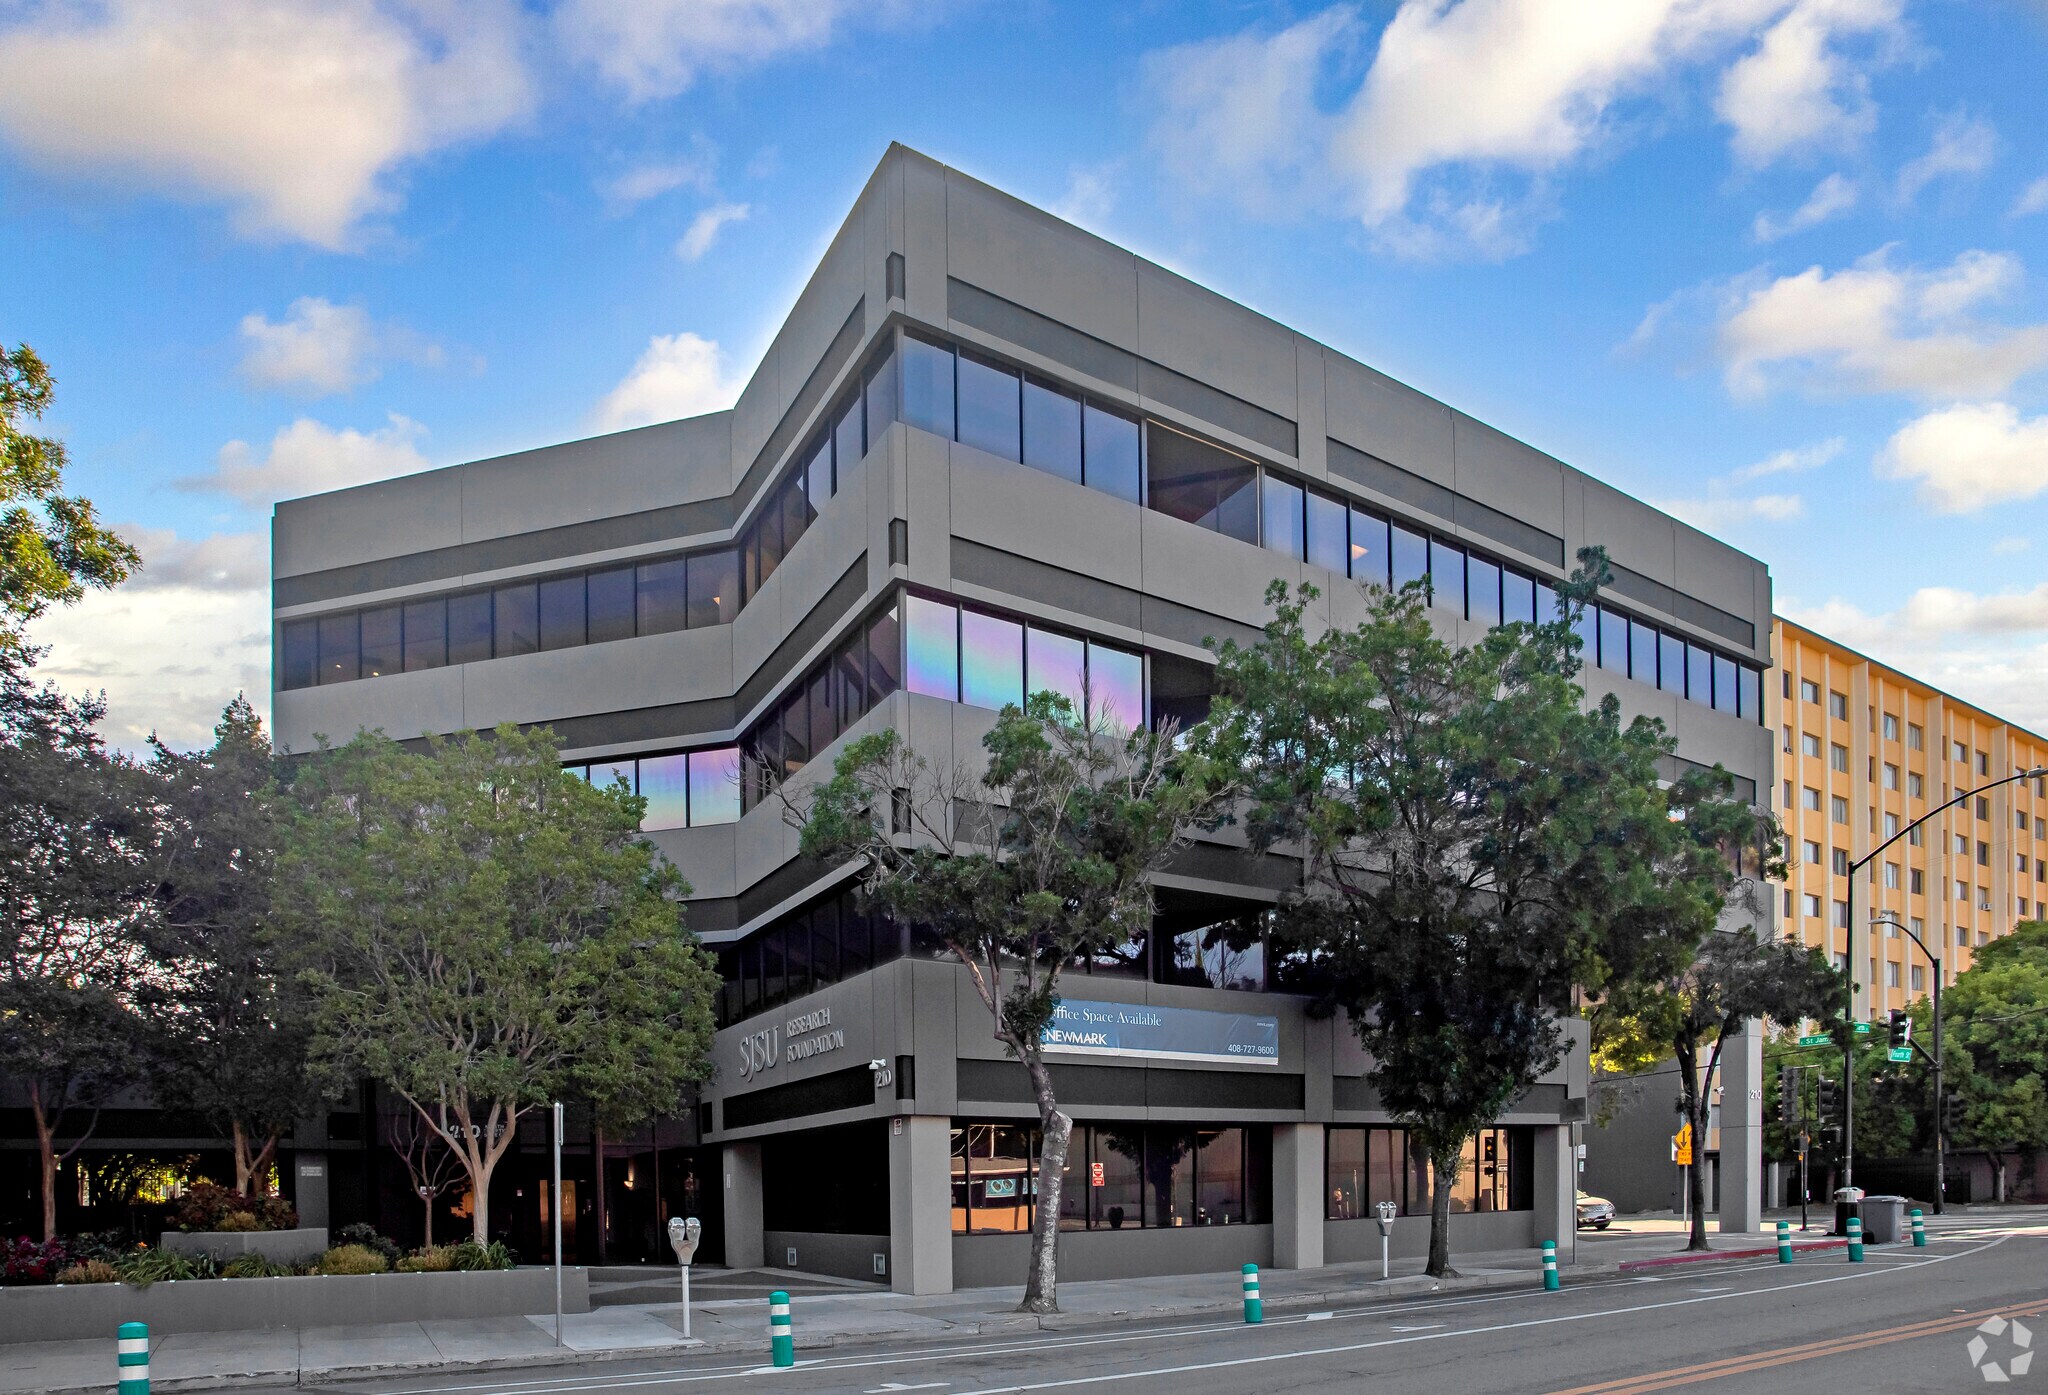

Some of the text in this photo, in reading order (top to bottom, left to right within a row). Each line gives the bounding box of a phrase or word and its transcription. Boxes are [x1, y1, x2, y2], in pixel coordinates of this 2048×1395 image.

[786, 1007, 831, 1038] RESEARCH
[1083, 1007, 1114, 1025] Space
[1117, 1012, 1162, 1027] Available
[786, 1029, 845, 1063] FOUNDATION
[1046, 1029, 1108, 1046] NEWMARK
[739, 1025, 779, 1083] SJSU
[1227, 1043, 1275, 1055] 408-727-9600
[875, 1069, 892, 1088] 210
[1750, 1089, 1761, 1099] 210
